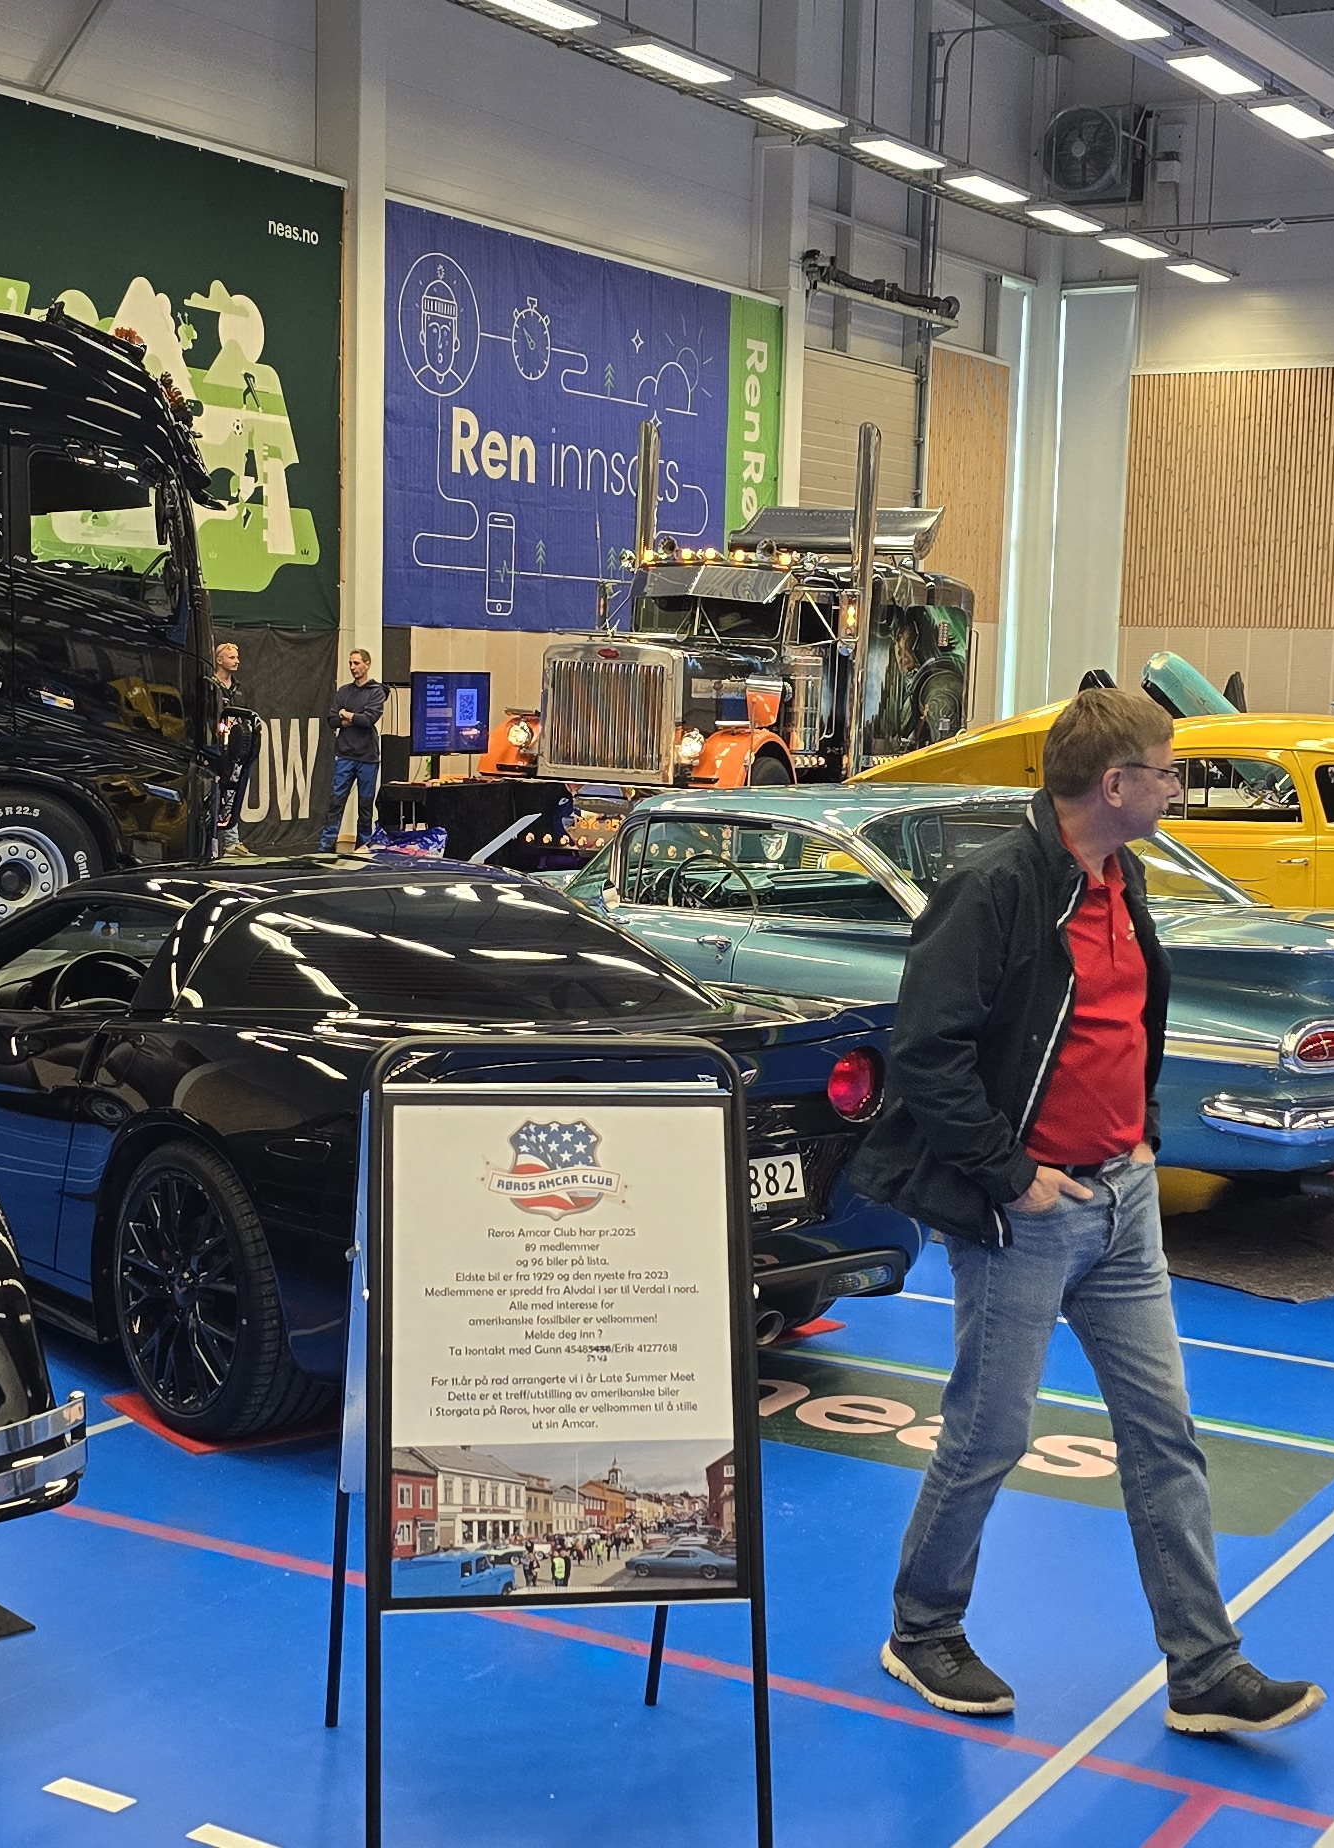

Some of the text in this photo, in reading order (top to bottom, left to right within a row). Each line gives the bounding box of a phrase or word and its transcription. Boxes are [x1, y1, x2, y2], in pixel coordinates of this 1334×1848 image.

[268, 220, 319, 245] neas.no
[451, 406, 536, 484] Ren
[5, 806, 14, 816] R
[15, 806, 41, 817] 22.5
[574, 816, 600, 831] Pete
[496, 1174, 613, 1191] RØROS AMCAR CLUB
[518, 1228, 550, 1237] Amcar
[554, 1227, 576, 1237] Club
[580, 1227, 595, 1237] har
[525, 1242, 600, 1252] 89 medlemmer
[516, 1255, 609, 1268] og 96 biler på lista.
[456, 1272, 485, 1282] Eldste
[488, 1272, 500, 1281] bil
[516, 1271, 530, 1281] fra
[533, 1272, 554, 1281] 1929
[557, 1273, 569, 1282] og
[573, 1271, 591, 1280] den
[594, 1271, 625, 1282] nyeste
[628, 1270, 641, 1280] fra
[644, 1271, 668, 1279] 2023
[425, 1287, 494, 1297] Medlemmene
[510, 1286, 543, 1297] spredd
[546, 1285, 560, 1295] fra
[563, 1285, 595, 1295] Alvdal
[621, 1285, 630, 1294] til
[633, 1284, 665, 1294] Verdal
[674, 1284, 698, 1293] nord.
[509, 1299, 614, 1310] Alle med interesse for
[469, 1315, 533, 1326] amerikanske
[537, 1315, 581, 1325] fossilbiler
[596, 1314, 657, 1324] velkommen!
[525, 1330, 555, 1340] Melde
[558, 1329, 577, 1340] deg
[580, 1330, 595, 1339] inn
[449, 1346, 462, 1356] Ta
[465, 1345, 506, 1356] kontakt
[509, 1345, 531, 1355] med
[534, 1345, 562, 1354] Gunn
[637, 1344, 677, 1352] 41277618
[432, 1377, 448, 1386] For
[475, 1375, 488, 1387] på
[491, 1375, 509, 1385] rad
[512, 1375, 566, 1385] arrangerte
[569, 1374, 578, 1383] vi
[586, 1373, 597, 1383] år
[600, 1373, 622, 1383] Late
[626, 1373, 667, 1382] Summer
[670, 1372, 695, 1381] Meet
[448, 1391, 476, 1401] Dette
[480, 1393, 489, 1401] er
[492, 1391, 502, 1400] et
[506, 1389, 572, 1400] treff/utstilling
[591, 1387, 655, 1398] amerikanske
[658, 1387, 679, 1396] biler
[436, 1407, 480, 1417] Storgata
[483, 1405, 496, 1417] på
[533, 1404, 555, 1414] hvor
[558, 1404, 576, 1413] alle
[592, 1403, 651, 1413] velkommen
[655, 1402, 663, 1411] til
[667, 1401, 673, 1411] å
[676, 1402, 697, 1411] stille
[532, 1419, 597, 1429] ut sin Amcar.
